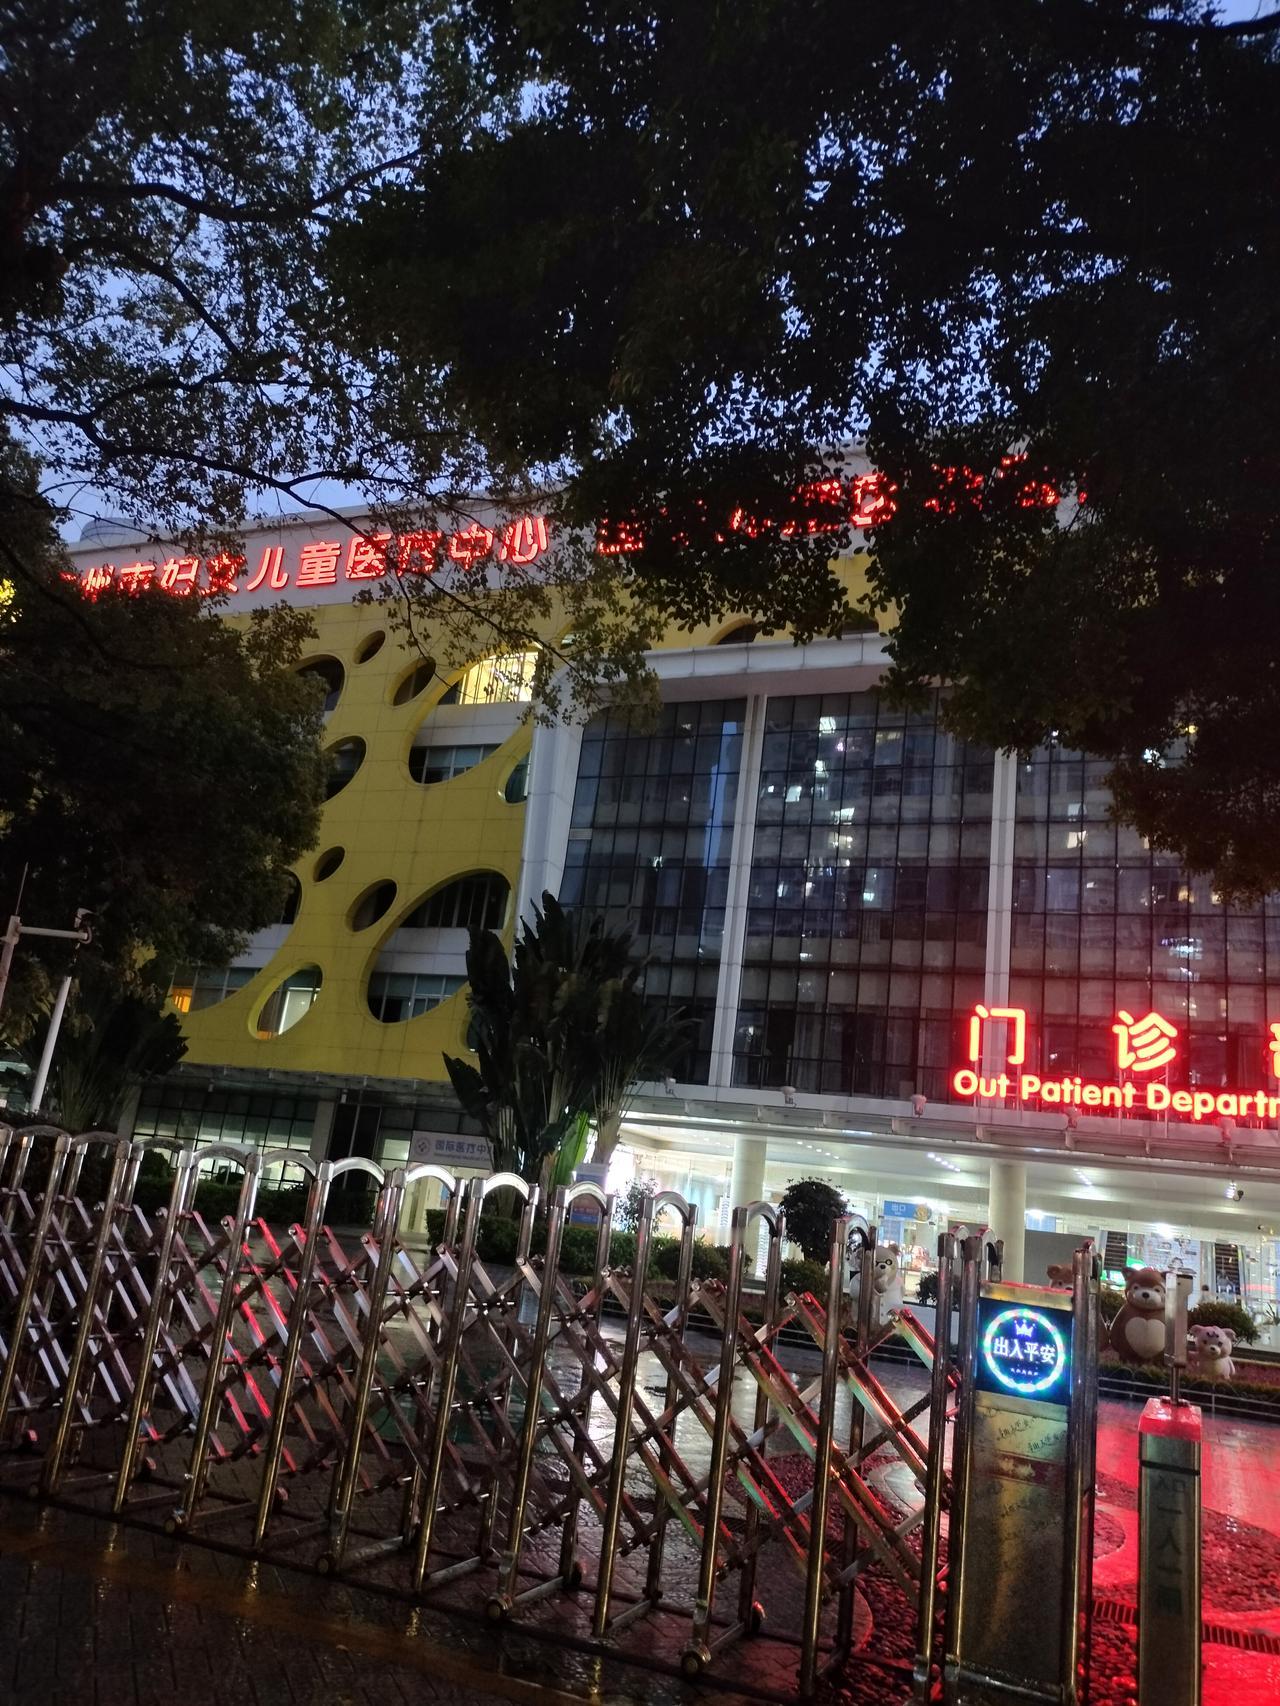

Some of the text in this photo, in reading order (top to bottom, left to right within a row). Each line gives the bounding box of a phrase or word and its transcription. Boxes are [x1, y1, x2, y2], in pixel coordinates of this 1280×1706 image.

[60, 515, 549, 603] 州市妇女儿童医疗中心
[953, 1069, 1010, 1098] Out
[1021, 1074, 1137, 1108] Patient
[993, 1336, 1056, 1365] 出入平安
